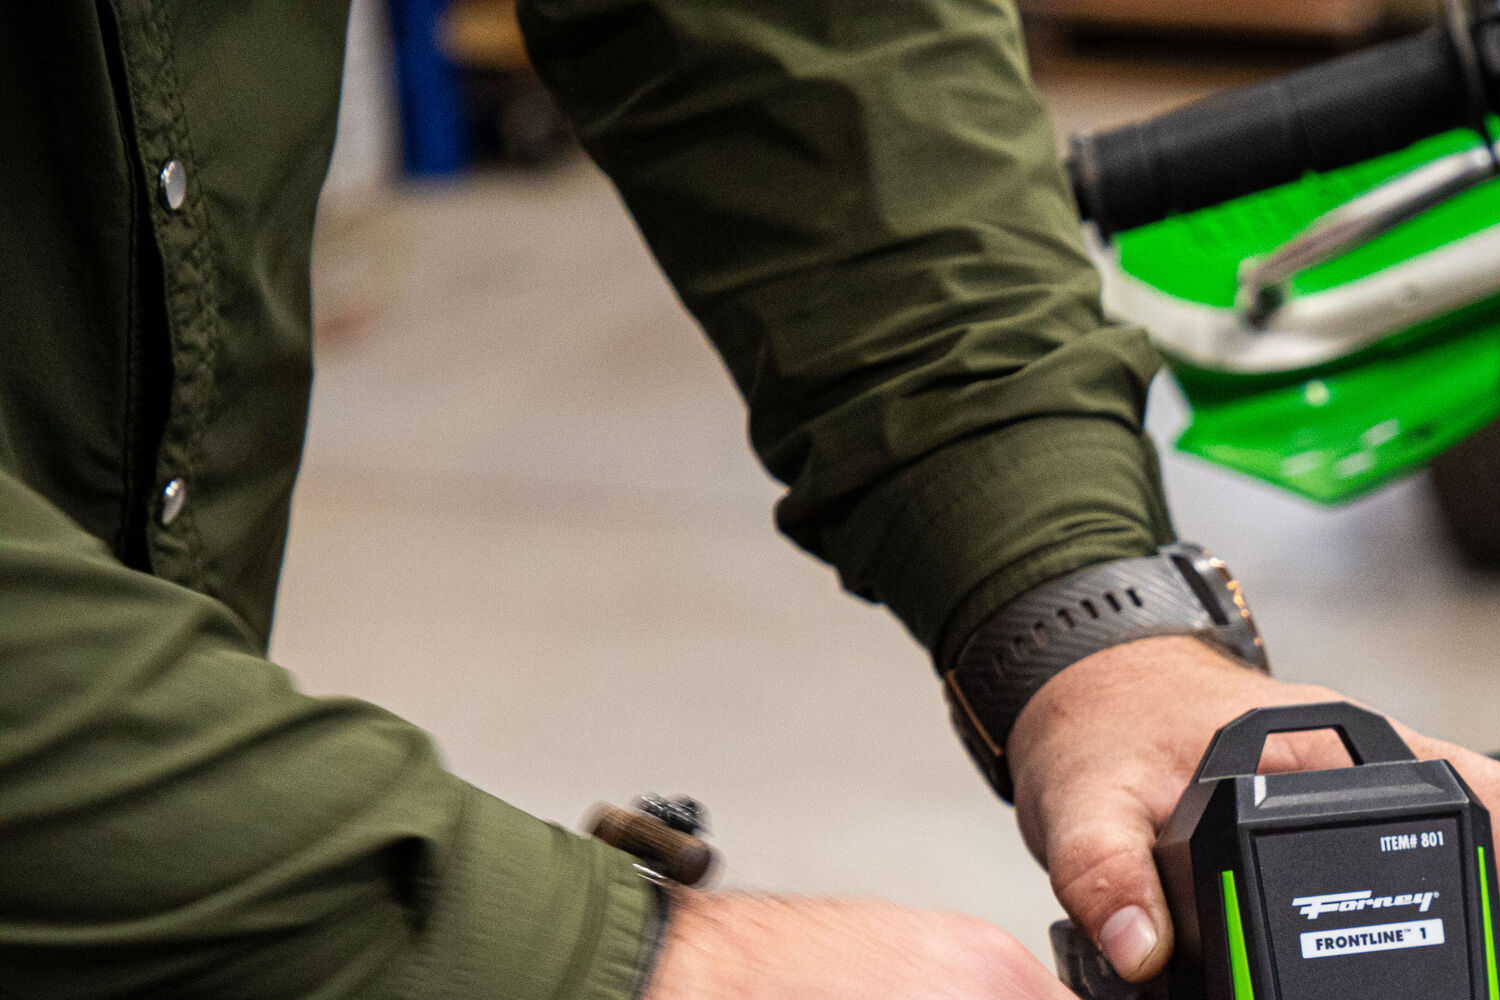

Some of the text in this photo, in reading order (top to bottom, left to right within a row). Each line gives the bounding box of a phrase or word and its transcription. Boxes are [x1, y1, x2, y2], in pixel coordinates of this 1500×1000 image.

[1380, 831, 1444, 852] ITEM# 801
[1419, 927, 1427, 940] 1
